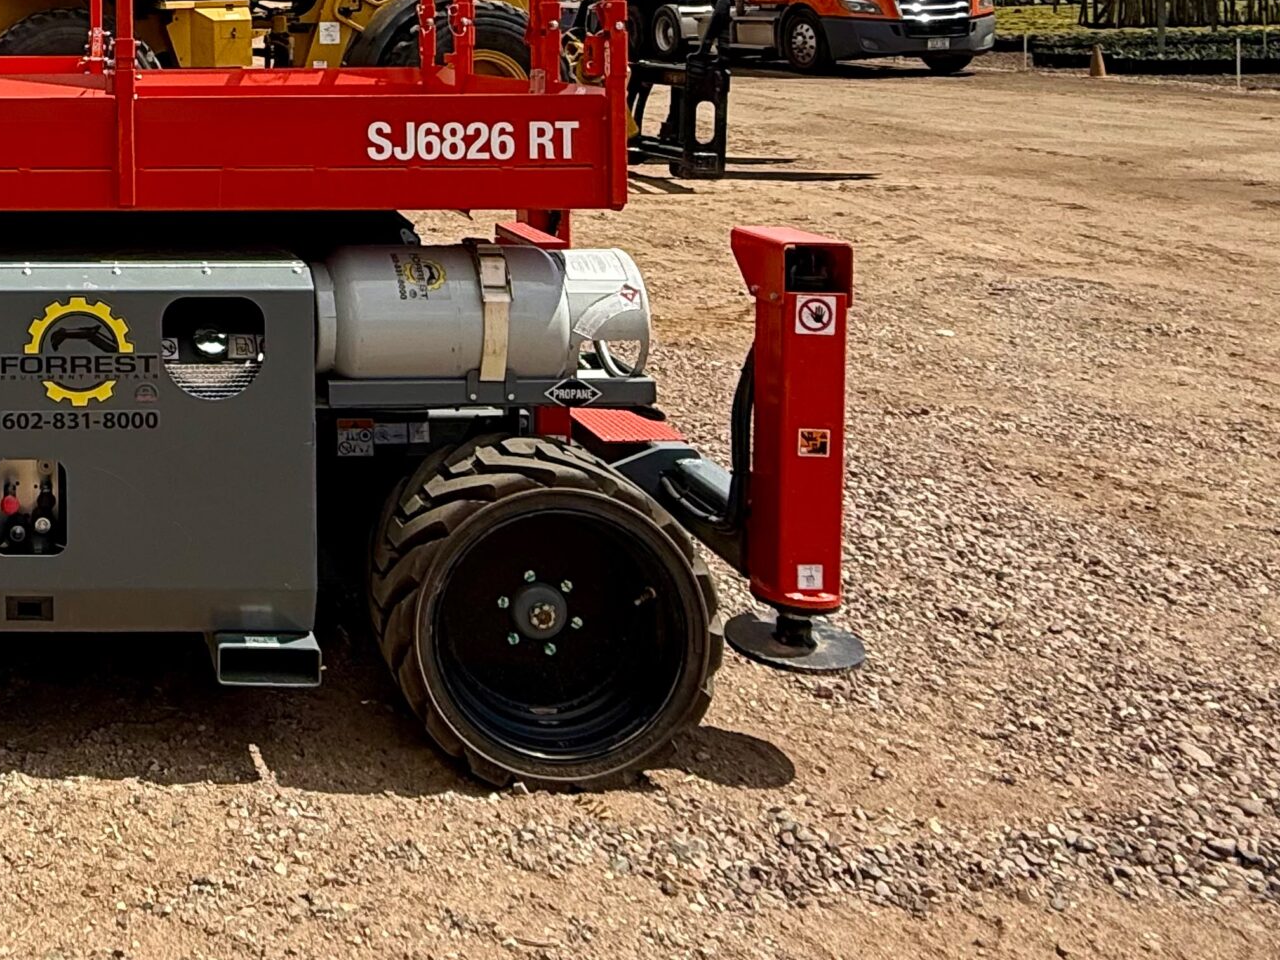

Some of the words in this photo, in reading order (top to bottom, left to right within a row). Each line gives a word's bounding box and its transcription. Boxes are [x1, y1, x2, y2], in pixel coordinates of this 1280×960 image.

[367, 121, 515, 160] SJ6826
[529, 121, 579, 159] RT
[1, 355, 158, 374] FORREST
[553, 389, 593, 400] PROPANE
[2, 412, 158, 430] 602-831-8000
